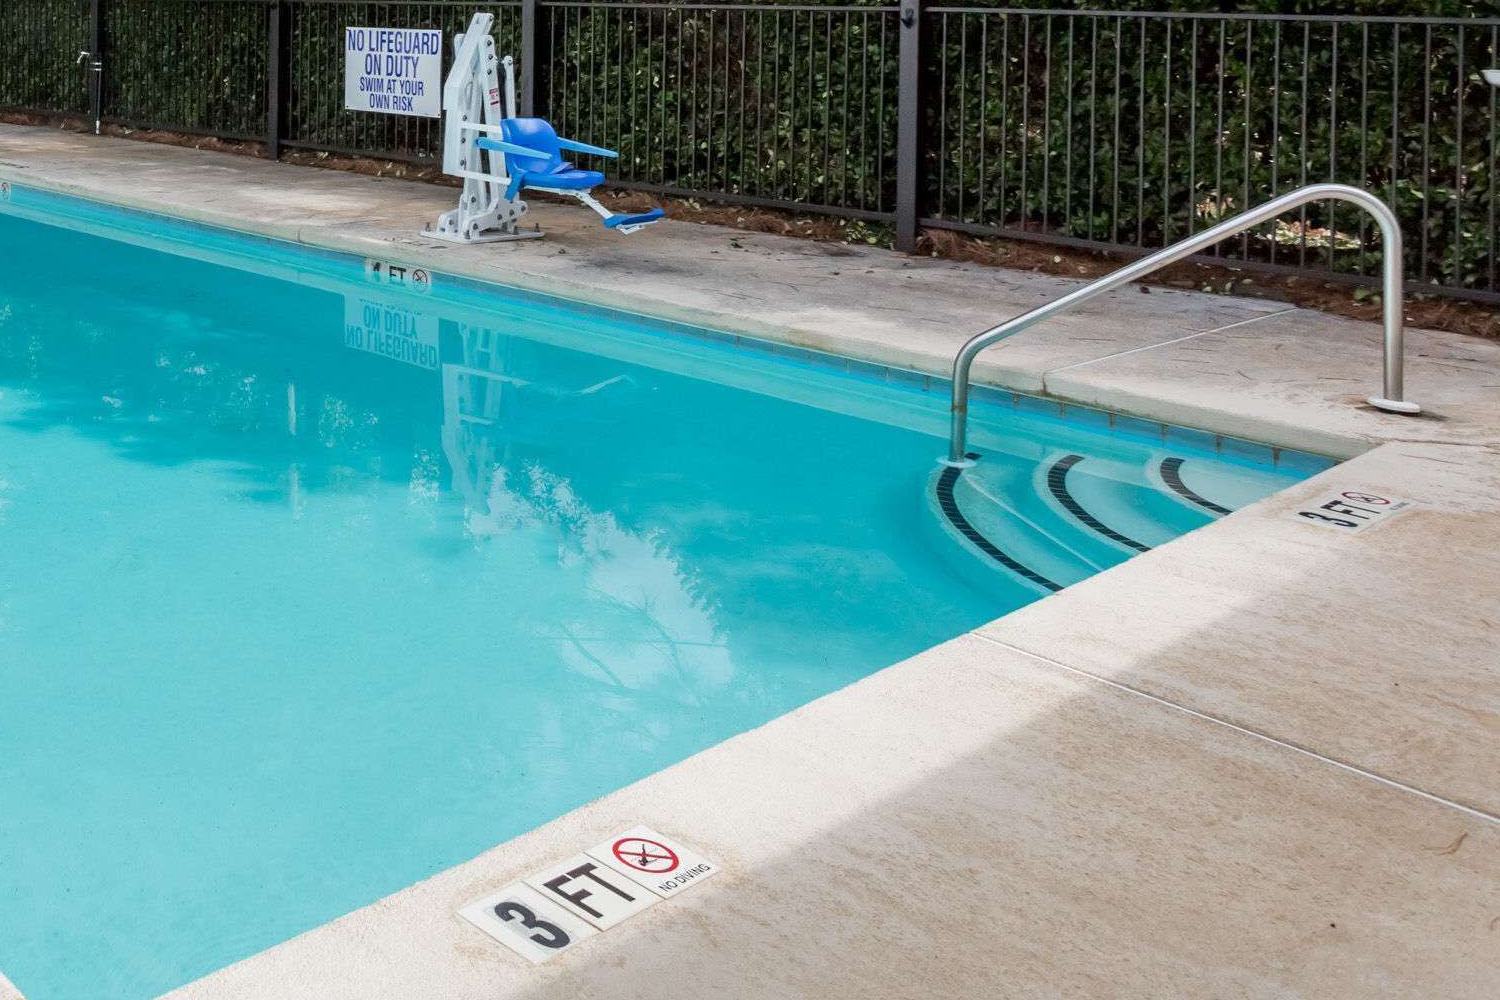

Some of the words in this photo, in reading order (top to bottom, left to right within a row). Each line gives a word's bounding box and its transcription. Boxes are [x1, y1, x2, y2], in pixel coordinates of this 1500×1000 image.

[347, 29, 365, 52] NO
[368, 30, 440, 55] LIFEGUARD
[364, 53, 381, 76] ON
[385, 55, 420, 79] DUTY
[359, 77, 384, 93] SWIM
[386, 79, 397, 94] AT
[399, 80, 424, 97] YOUR
[369, 93, 390, 110] OWN
[392, 95, 414, 112] RISK
[389, 265, 407, 280] FT
[1298, 511, 1359, 528] 3
[1320, 499, 1381, 520] FT
[658, 880, 679, 893] NO
[674, 863, 711, 884] DIVING
[494, 901, 571, 949] 3
[543, 862, 637, 919] FT
